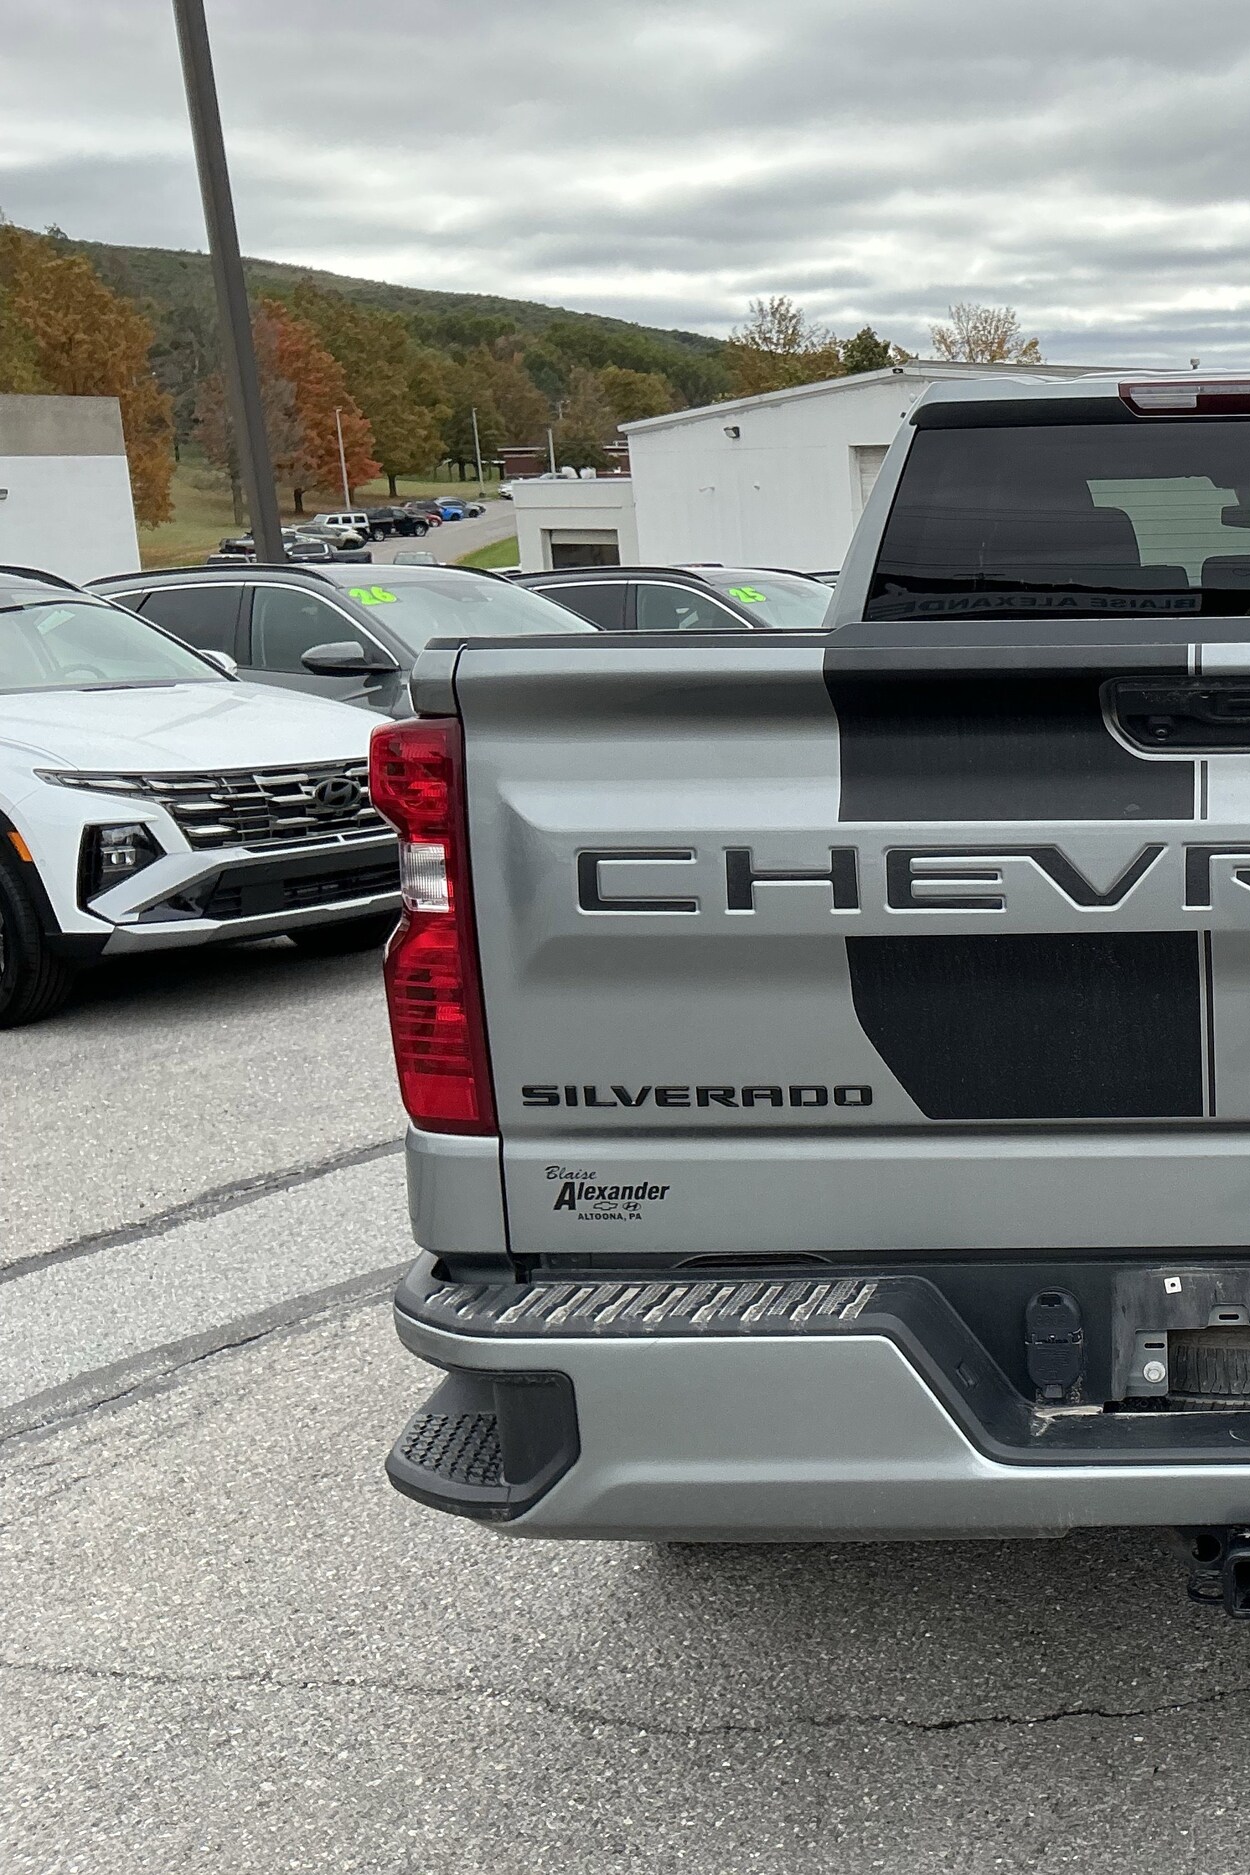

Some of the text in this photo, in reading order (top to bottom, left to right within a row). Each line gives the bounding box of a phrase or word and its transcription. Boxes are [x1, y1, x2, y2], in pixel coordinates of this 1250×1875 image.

[348, 585, 398, 606] 26
[728, 586, 768, 604] 25
[521, 1084, 873, 1108] SILVERADO
[544, 1165, 597, 1180] Blaise
[553, 1181, 670, 1211] Alexander
[577, 1212, 642, 1221] ALTOONA, PA
